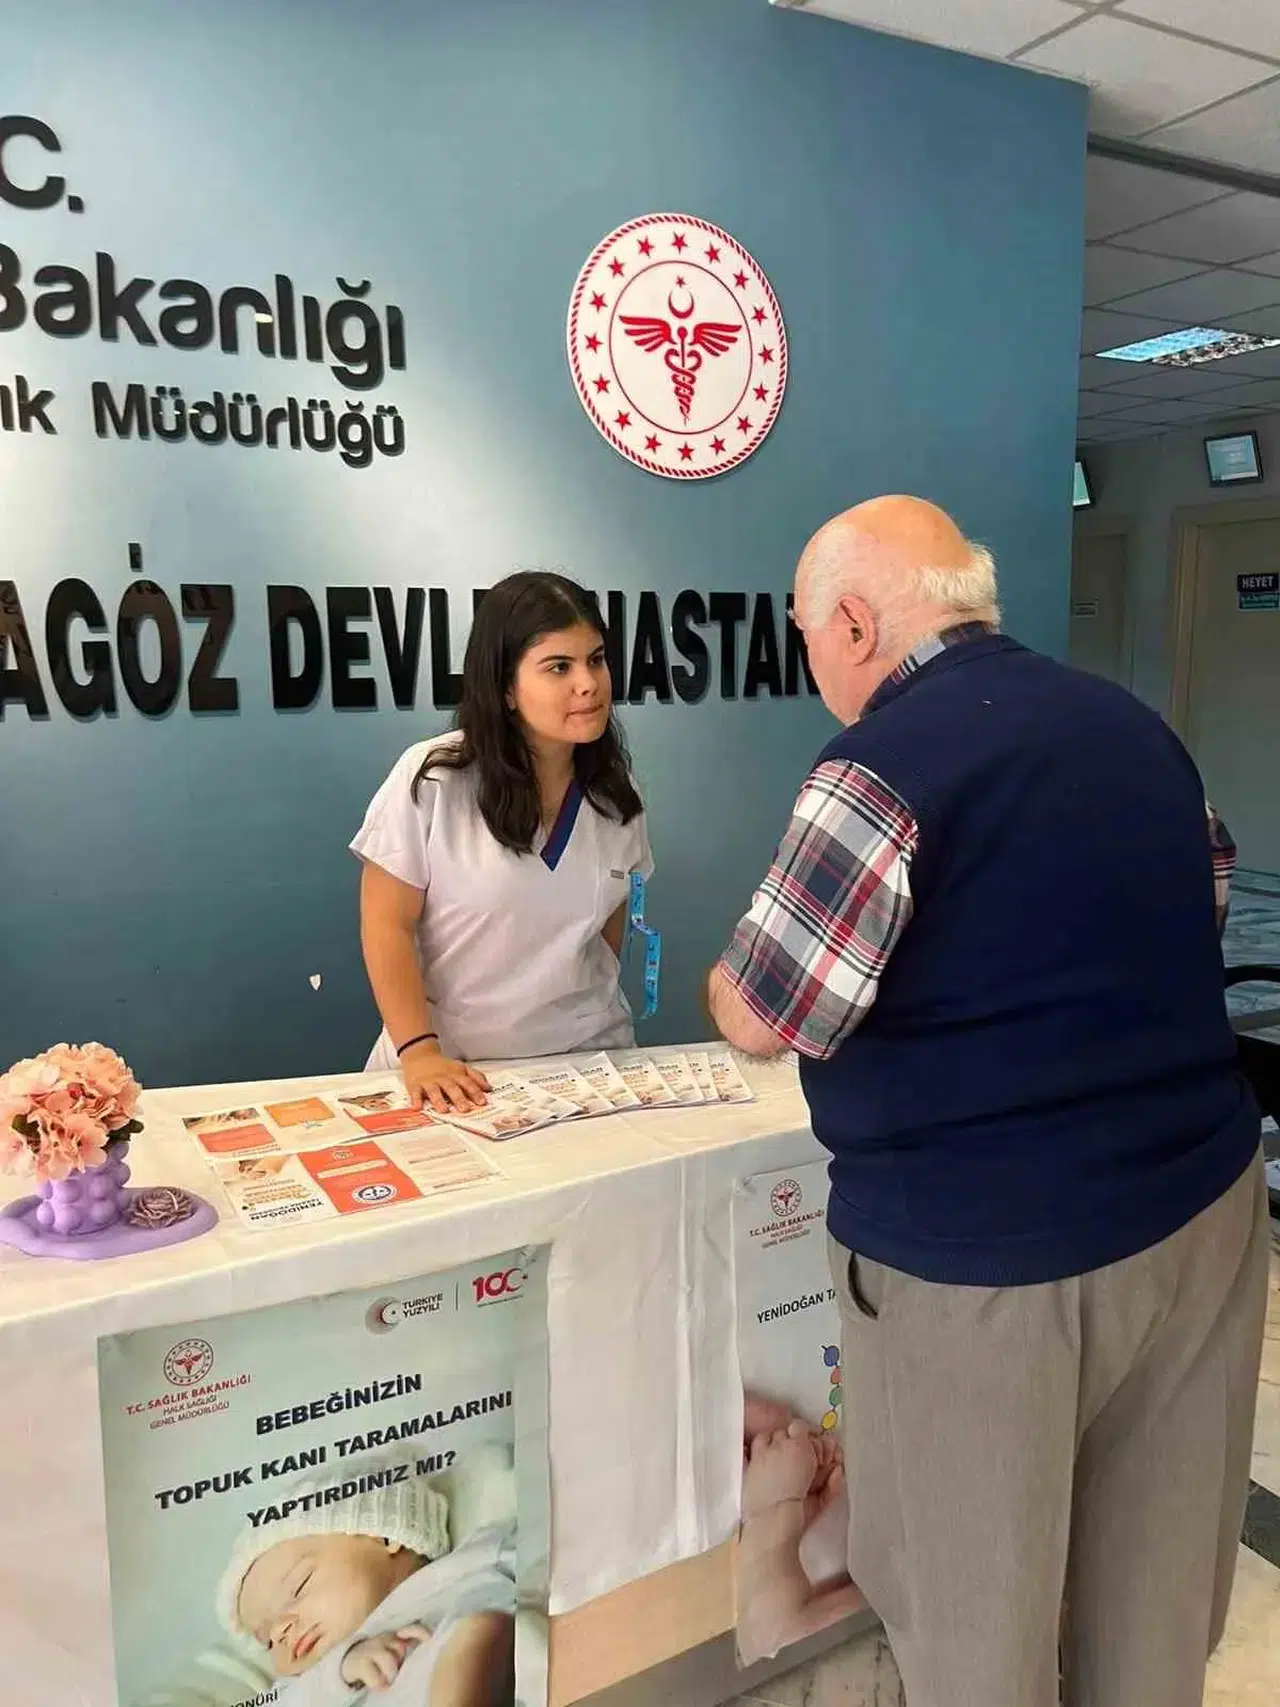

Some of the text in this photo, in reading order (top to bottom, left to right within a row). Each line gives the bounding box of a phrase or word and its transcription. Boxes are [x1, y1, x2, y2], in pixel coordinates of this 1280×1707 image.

[0, 115, 84, 212] C.
[92, 381, 405, 468] Müdürlüğü
[1242, 576, 1273, 589] HEYET
[266, 584, 491, 713] DEVL
[584, 588, 822, 707] HASTAN
[472, 1268, 525, 1303] 100
[757, 1291, 825, 1324] YENİDOĞAN
[125, 1373, 251, 1416] T.C. SAĞLIK BAKANLIĞI
[256, 1373, 422, 1436] BEBEĞİNİZİN
[155, 1390, 513, 1510] TOPUK KANI TARAMALARINI
[247, 1449, 457, 1528] YAPTIRDINIZ MI?
